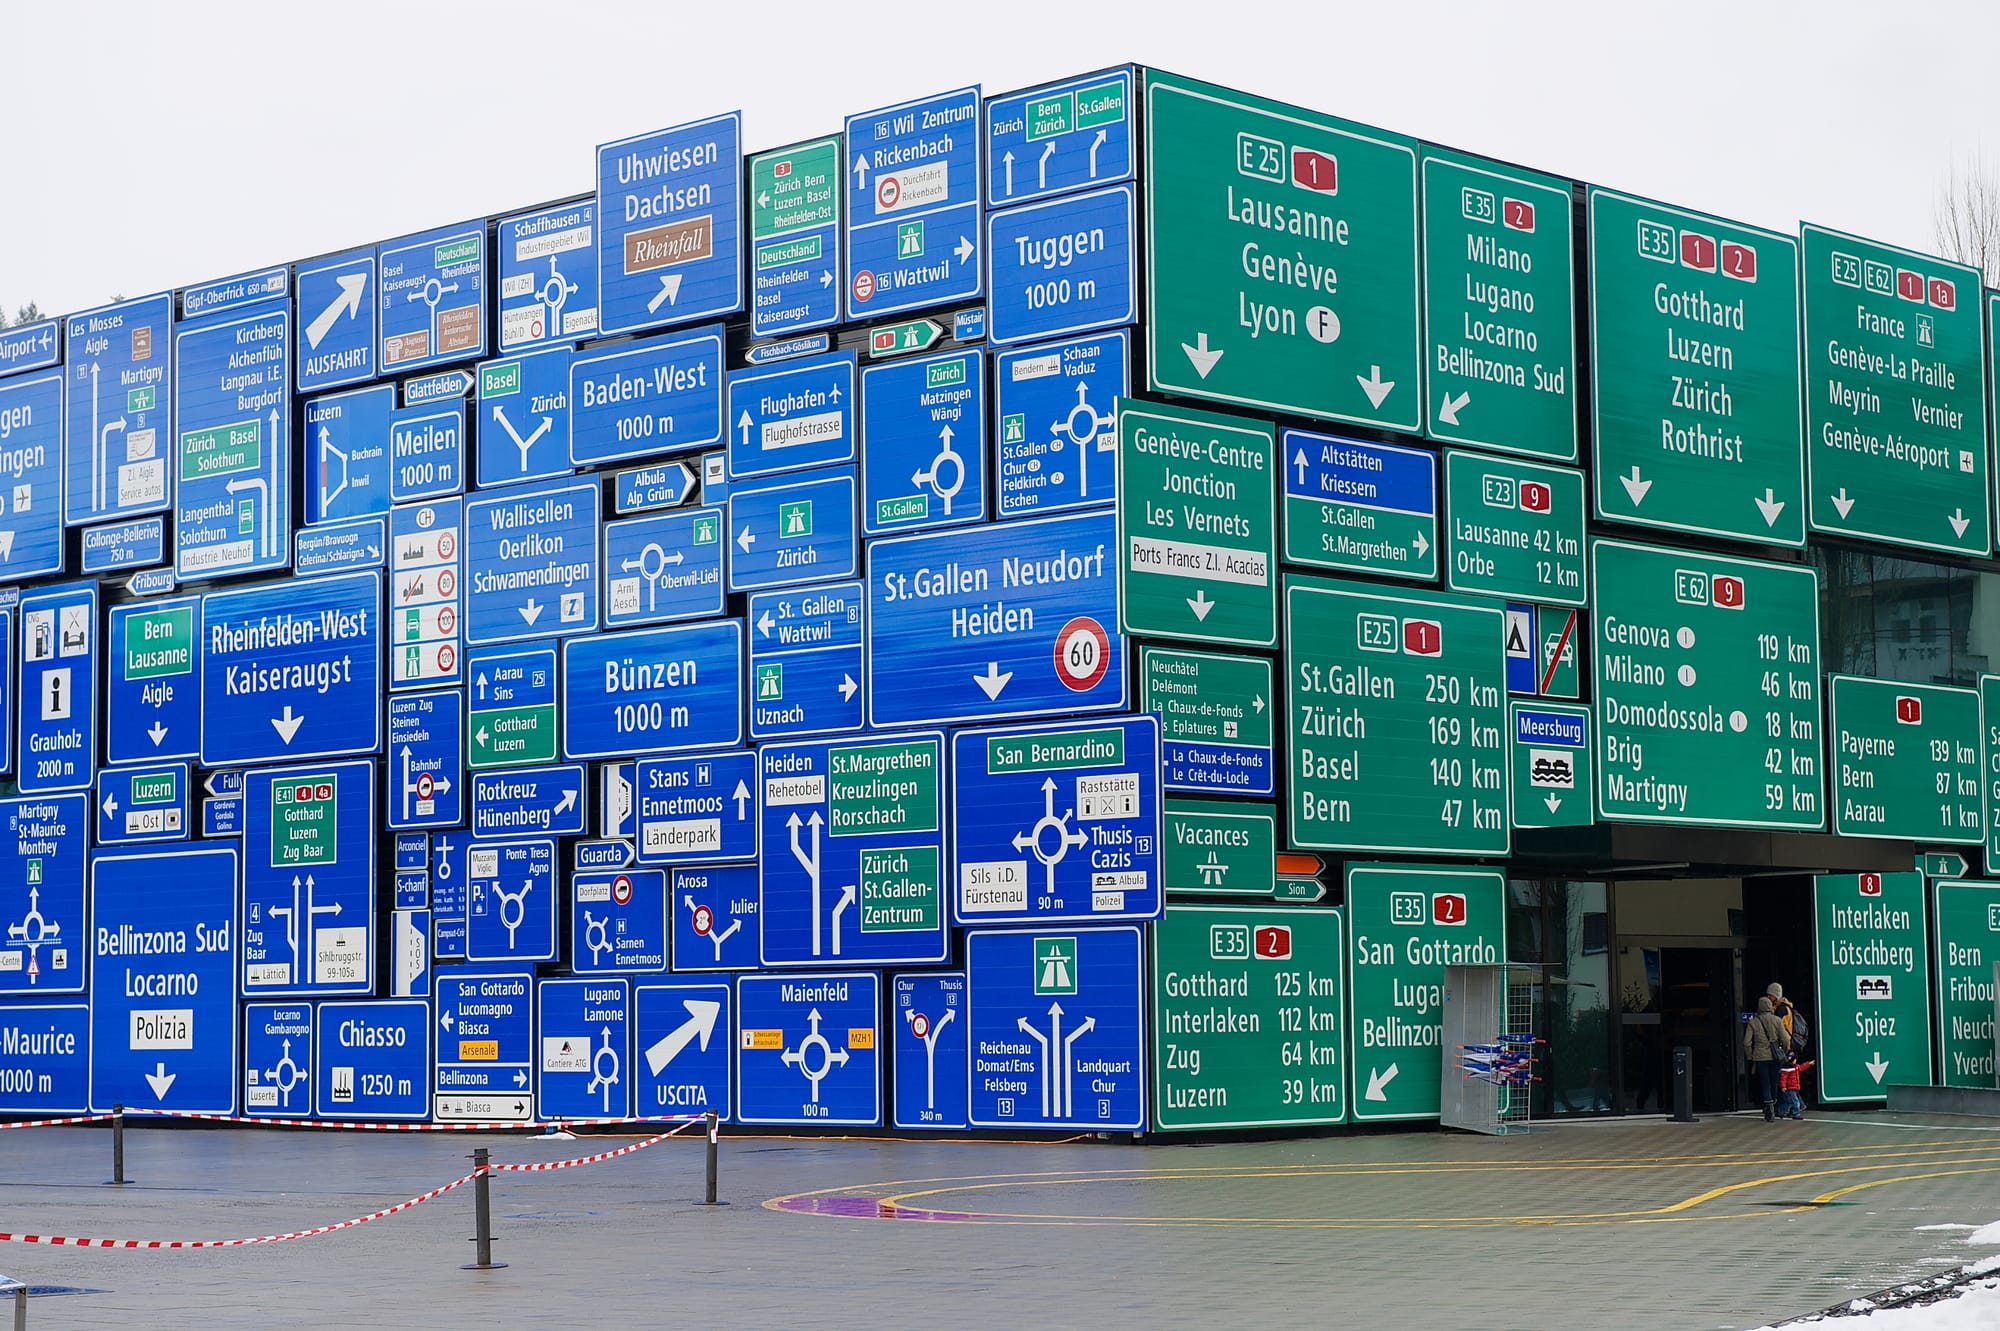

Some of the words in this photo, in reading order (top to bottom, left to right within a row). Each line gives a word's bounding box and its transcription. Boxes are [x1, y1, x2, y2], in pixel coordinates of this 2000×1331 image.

[1079, 96, 1121, 115] St.Gallen
[875, 130, 952, 168] Rickenbach
[619, 143, 716, 183] Uhwiesen
[774, 177, 800, 194] Zürich
[805, 175, 824, 187] Bern
[904, 170, 940, 186] Durchfahrt
[626, 184, 710, 221] Dachsen
[1228, 182, 1348, 245] Lausanne
[515, 214, 579, 237] Schaffhausen
[774, 206, 831, 228] Rheinfelden-Ost
[634, 228, 703, 263] Rheinfall
[761, 241, 815, 264] Deutschland
[1015, 229, 1103, 269] Tuggen
[1468, 234, 1531, 273] Milano
[894, 260, 949, 288] Wattwil
[1243, 243, 1337, 293] Genève
[187, 284, 244, 311] Gipf-Oberfrick
[1025, 279, 1070, 309] 1000
[1079, 280, 1095, 300] m
[1240, 292, 1295, 338] Lyon
[1655, 283, 1743, 330] Gotthard
[71, 323, 84, 337] Les
[89, 315, 123, 333] Mosses
[957, 313, 982, 326] Müstair
[1858, 305, 1904, 338] France
[237, 324, 283, 344] Kirchberg
[1465, 312, 1537, 352] Locarno
[85, 336, 108, 356] Aigle
[229, 344, 282, 369] Alchenflüh
[761, 340, 820, 358] Fischbach-Göslikon
[306, 347, 368, 376] AUSFAHRT
[1064, 361, 1095, 376] Vaduz
[1438, 345, 1524, 387] Bellinzona
[1534, 364, 1564, 394] Sud
[1829, 340, 1906, 379] Genève-La
[1912, 359, 1954, 389] Praille
[122, 366, 163, 385] Martigny
[487, 369, 516, 390] Basel
[584, 362, 706, 407] Baden-West
[238, 386, 282, 411] Burgdorf
[408, 377, 462, 399] Glattfelden
[921, 389, 971, 407] Matzingen
[309, 406, 341, 422] Luzern
[761, 390, 825, 416] Flughafen
[1829, 380, 1880, 415] Meyrin
[1912, 397, 1963, 430] Vernier
[187, 434, 215, 453] Zürich
[231, 426, 256, 445] Basel
[397, 425, 455, 457] Meilen
[766, 421, 839, 444] Flughofstrasse
[352, 448, 382, 460] Buchrain
[1135, 428, 1263, 469] Genève-Centre
[1823, 422, 1949, 470] Genève-Aéroport
[1321, 446, 1382, 471] Altstätten
[635, 470, 665, 487] Albula
[1004, 473, 1046, 491] Feldkirch
[1163, 467, 1235, 500] Jonction
[181, 499, 233, 524] Langenthal
[491, 500, 572, 530] Wallisellen
[1147, 501, 1173, 527] Les
[1184, 506, 1249, 537] Vernets
[86, 526, 159, 548] Collonge-Bellerive
[180, 526, 226, 545] Solothurn
[299, 534, 358, 551] Bergün/Bravuogn
[184, 551, 218, 566] Industrie
[222, 544, 250, 560] Neuhof
[1322, 534, 1406, 561] St.Margrethen
[1134, 544, 1161, 564] Ports
[1168, 548, 1200, 568] Francs
[1206, 553, 1220, 571] Z.I.
[1226, 555, 1264, 576] Acacias
[1458, 551, 1494, 576] Orbe
[1537, 561, 1551, 583] 12
[1557, 562, 1578, 587] km
[135, 572, 173, 588] Fribourg
[475, 561, 589, 593] Schwamendingen
[661, 568, 718, 589] Oberwil-Lieli
[885, 563, 987, 601] St.Gallen
[1003, 545, 1104, 588] Neudorf
[953, 602, 1033, 637] Heiden
[212, 609, 367, 654] Rheinfelden-West
[1605, 616, 1669, 648] Genova
[130, 648, 187, 669] Lausanne
[1071, 642, 1092, 667] 60
[227, 655, 351, 695] Kaiseraugst
[606, 658, 696, 692] Bünzen
[1152, 660, 1198, 675] Neuchâtel
[1301, 663, 1394, 698] St.Gallen
[1426, 674, 1459, 704] 250
[1470, 677, 1498, 707] km
[495, 714, 536, 732] Gotthard
[757, 704, 803, 725] Uznach
[1607, 697, 1723, 732] Domodossola
[30, 728, 81, 752] Grauholz
[392, 729, 429, 743] Einsiedeln
[1521, 717, 1580, 742] Meersburg
[997, 747, 1022, 764] San
[1032, 739, 1114, 762] Bernardino
[1842, 731, 1894, 760] Payerne
[1930, 740, 1949, 762] 139
[1957, 740, 1974, 764] km
[411, 758, 441, 771] Bahnhof
[1174, 768, 1183, 780] Le
[1188, 769, 1249, 784] Crêt-du-Locle
[136, 782, 171, 798] Luzern
[479, 780, 536, 801] Rotkreuz
[769, 780, 821, 798] Rehetobel
[833, 779, 917, 801] Kreuzlingen
[1081, 779, 1135, 793] Raststätte
[1609, 774, 1687, 811] Martigny
[1766, 784, 1783, 809] 59
[1793, 784, 1814, 811] km
[19, 805, 58, 824] Martigny
[285, 805, 323, 821] Gotthard
[479, 805, 549, 828] Hünenberg
[19, 822, 65, 838] St-Maurice
[647, 825, 716, 847] Länderpark
[1091, 825, 1132, 845] Thusis
[1175, 823, 1248, 846] Vacances
[506, 849, 527, 859] Ponte
[530, 848, 548, 858] Tresa
[581, 845, 621, 863] Guarda
[398, 875, 428, 896] S-chanf
[678, 875, 707, 888] Arosa
[1289, 883, 1305, 895] Sion
[966, 889, 1022, 904] Fürstenau
[1833, 903, 1909, 929] Interlaken
[98, 925, 185, 955] Bellinzona
[196, 920, 228, 952] Sud
[616, 937, 644, 949] Sarnen
[1358, 936, 1394, 964] San
[1407, 936, 1495, 965] Gottardo
[1832, 939, 1913, 972] Lötschberg
[126, 968, 197, 996] Locarno
[782, 982, 847, 1002] Maienfeld
[459, 1002, 512, 1018] Lucomagno
[1166, 1007, 1259, 1033] Interlaken
[1279, 1008, 1301, 1031] 112
[1310, 1006, 1334, 1030] km
[137, 1015, 185, 1039] Polizia
[265, 1023, 309, 1037] Gambarogno
[340, 1020, 405, 1046] Chiasso
[1856, 1011, 1895, 1043] Spiez
[462, 1044, 495, 1055] Arsenale
[980, 1041, 1030, 1054] Reichenau
[977, 1059, 1034, 1072] Domat/Ems
[1077, 1059, 1130, 1076] Landquart
[251, 1091, 275, 1100] Luserte
[361, 1075, 392, 1095] 1250
[399, 1080, 411, 1095] m
[658, 1085, 707, 1105] USCITA
